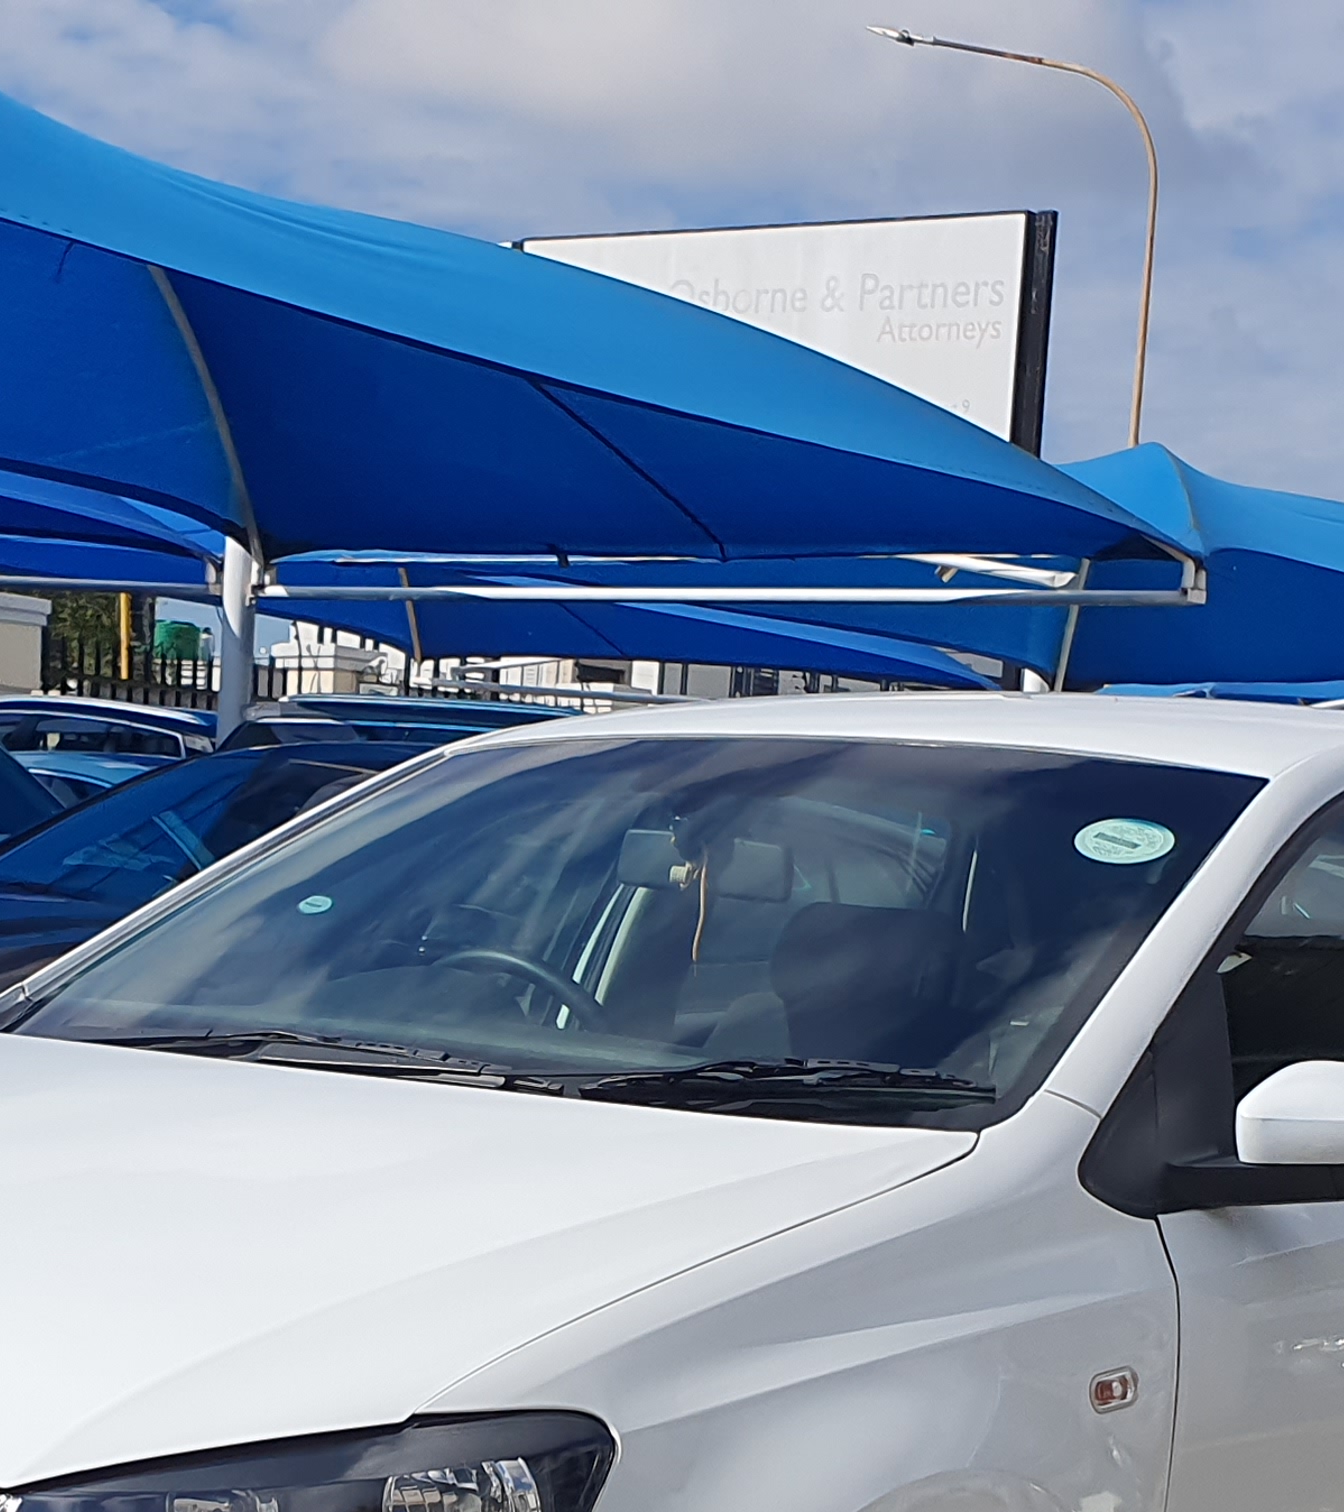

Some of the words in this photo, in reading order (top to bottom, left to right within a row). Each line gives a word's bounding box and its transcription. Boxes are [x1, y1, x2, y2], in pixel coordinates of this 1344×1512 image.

[820, 275, 845, 313] &
[859, 273, 1005, 312] Partners
[876, 316, 1003, 350] Attorneys
